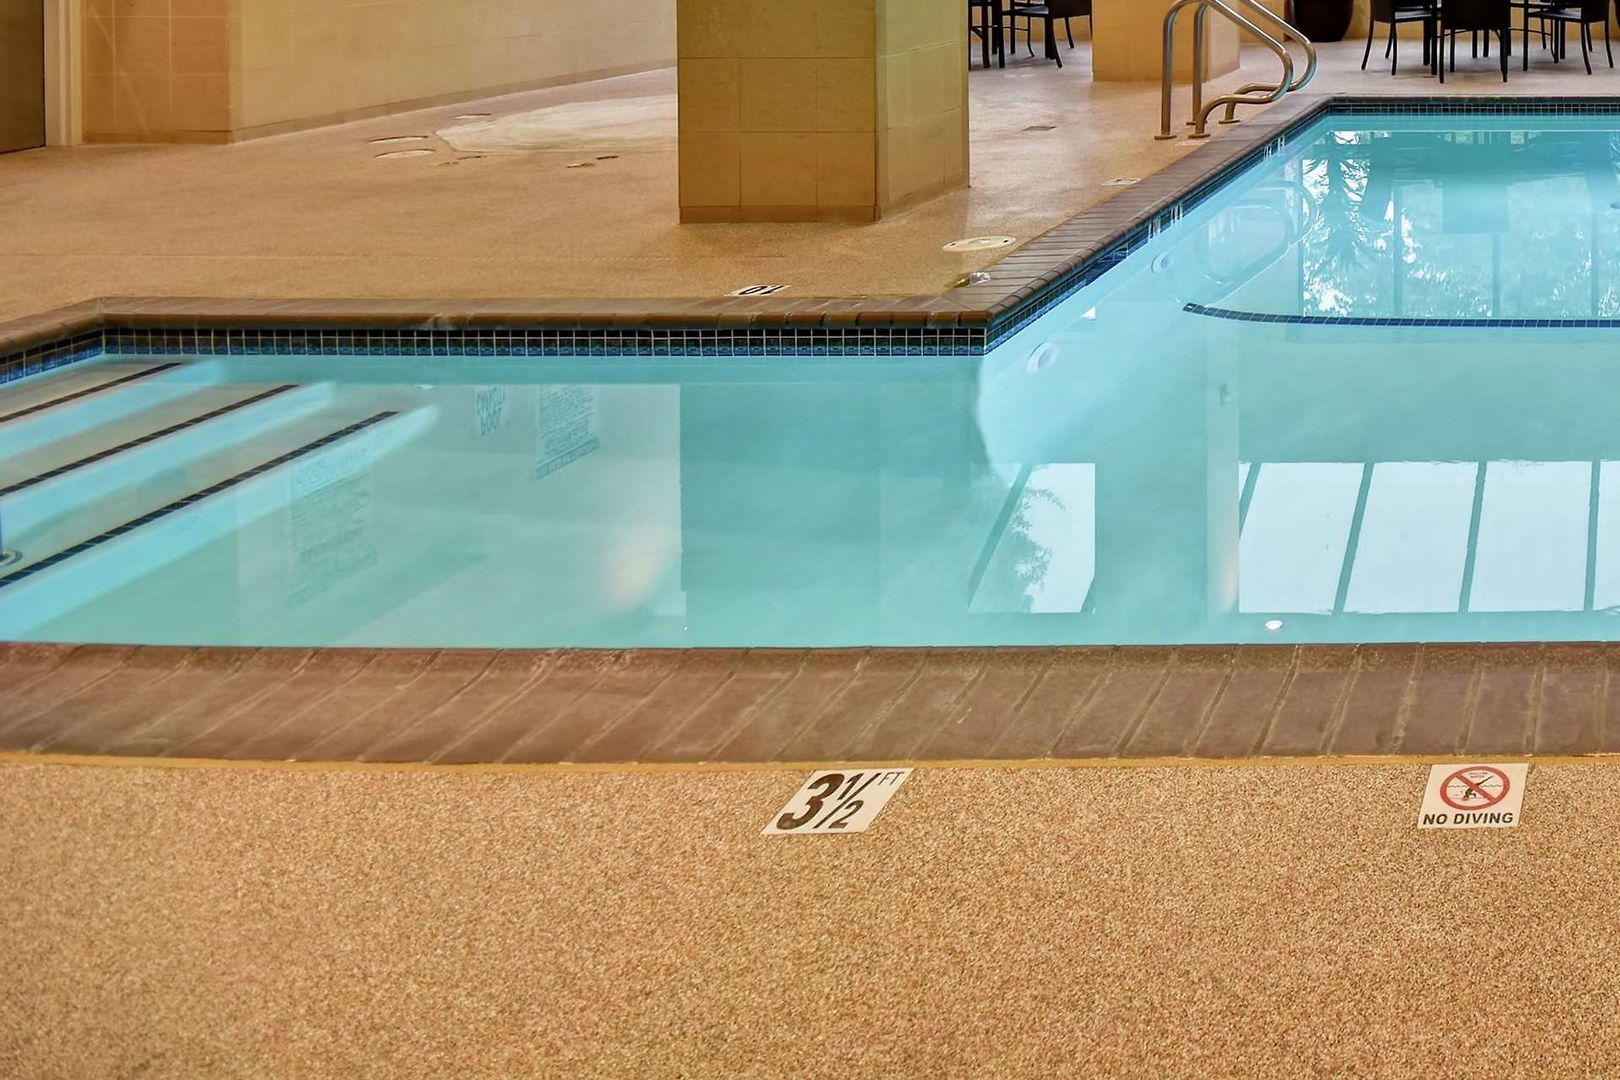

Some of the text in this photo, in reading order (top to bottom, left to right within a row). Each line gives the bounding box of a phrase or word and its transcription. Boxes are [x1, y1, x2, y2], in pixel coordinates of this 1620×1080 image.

[878, 771, 905, 786] FT
[1423, 812, 1513, 824] NO DIVING
